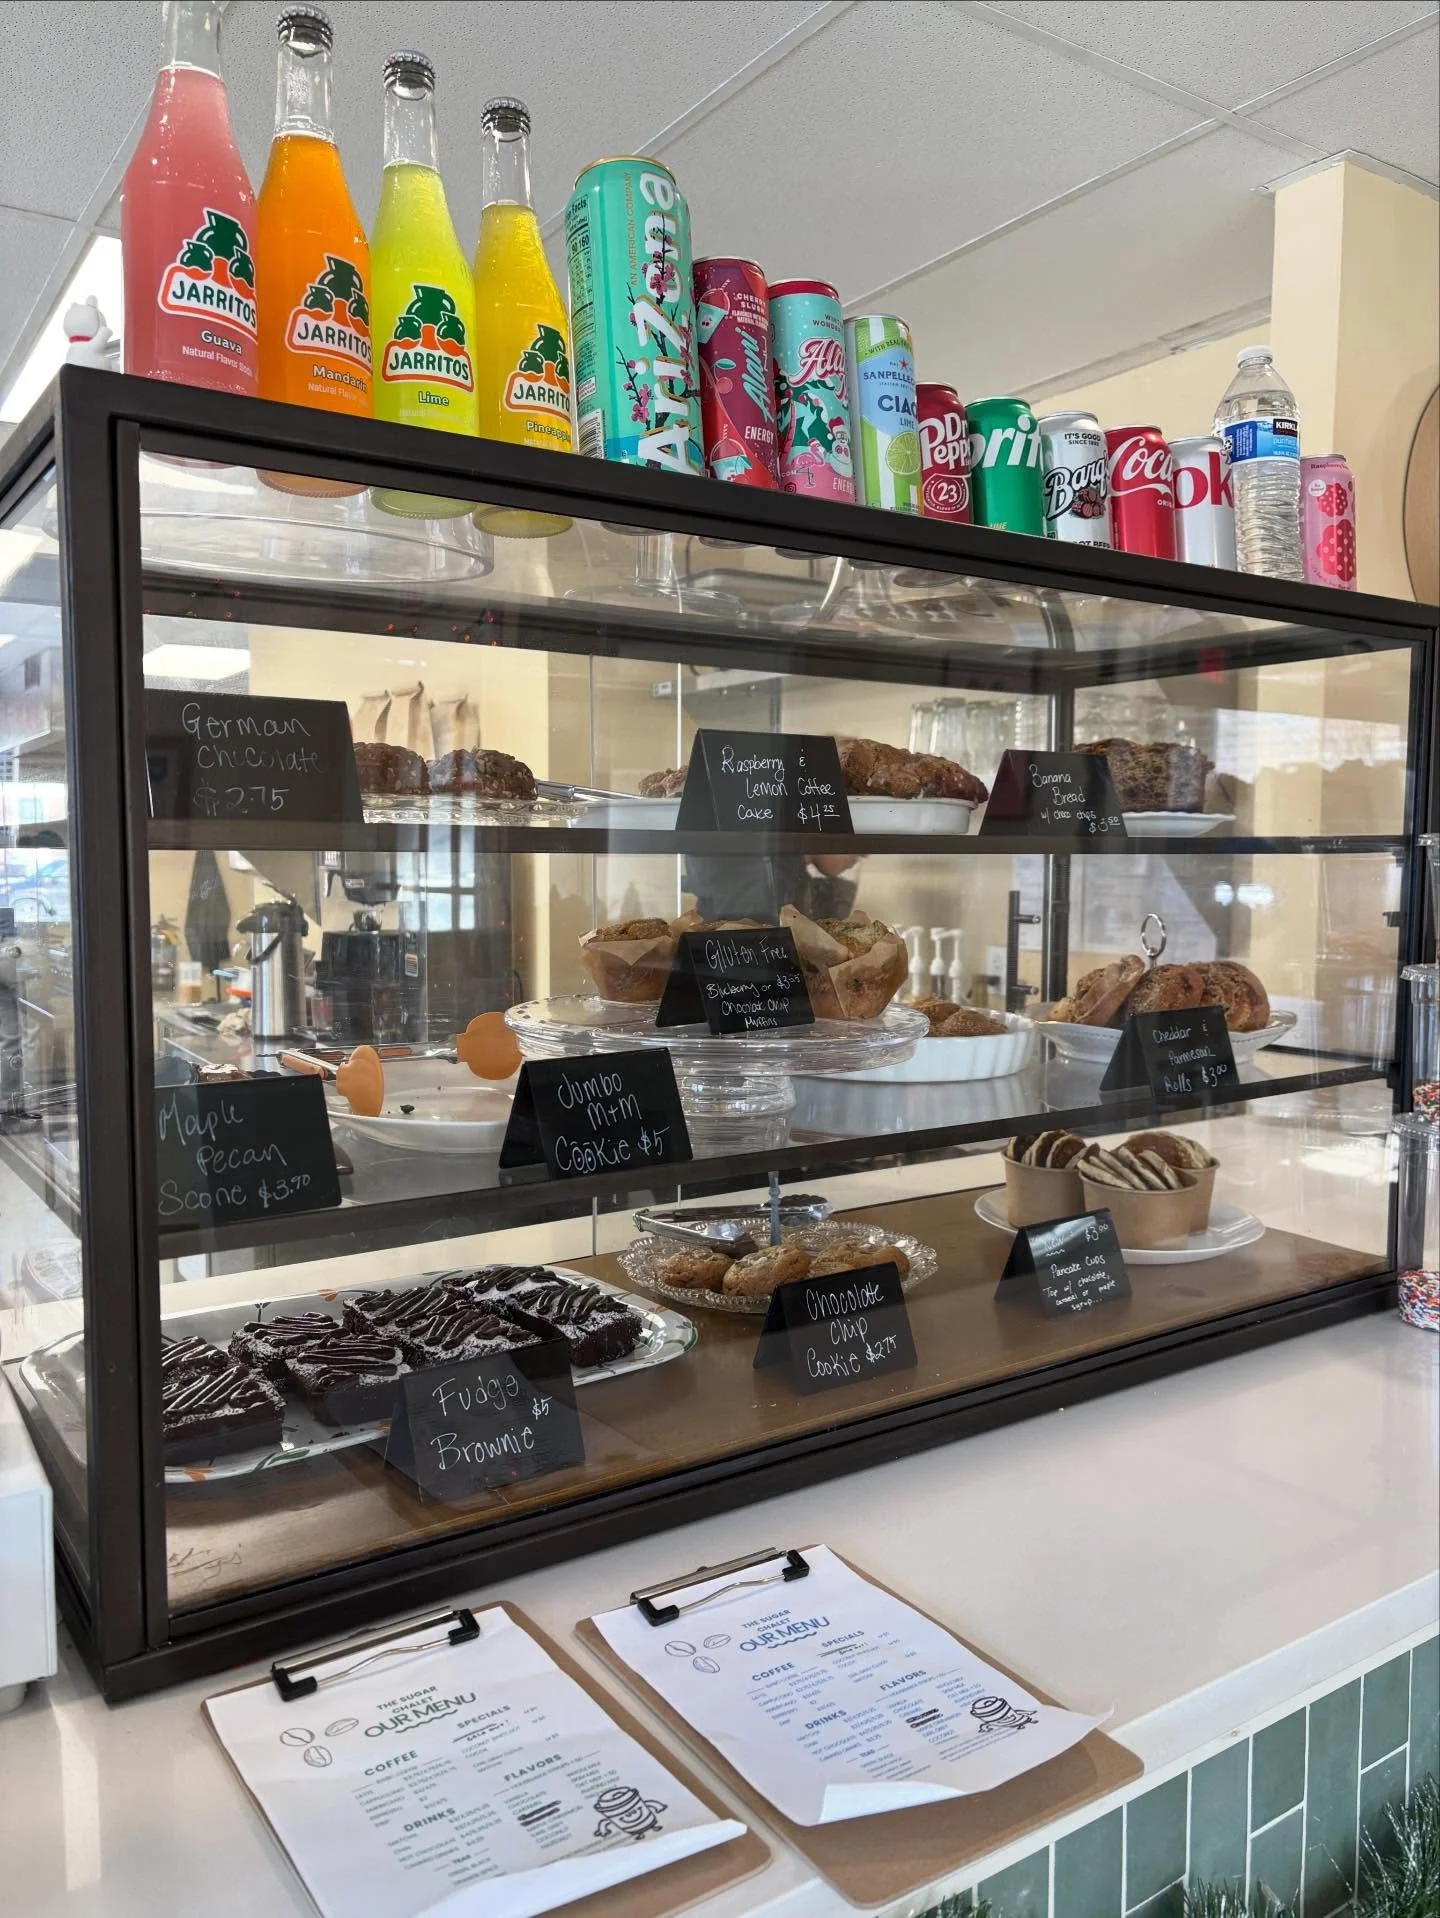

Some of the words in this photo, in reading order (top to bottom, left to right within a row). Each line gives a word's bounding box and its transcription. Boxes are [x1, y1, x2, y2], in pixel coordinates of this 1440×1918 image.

[172, 280, 257, 329] JARRITOS
[182, 346, 215, 360] Natural
[201, 330, 242, 355] Guava
[389, 352, 470, 382] JARRITOS
[308, 383, 337, 395] Natural
[418, 390, 449, 406] Lime
[744, 425, 774, 445] ENERGY
[943, 412, 969, 442] Dr
[937, 482, 959, 503] 23
[181, 702, 312, 740] German
[721, 744, 785, 783] Raspberry
[1028, 763, 1072, 788] Banana
[746, 778, 788, 799] Lemon
[797, 776, 836, 797] Coffee
[1052, 786, 1087, 806] Bread
[737, 804, 774, 821] Cake
[759, 935, 788, 964] Free
[761, 984, 772, 993] or
[1152, 1025, 1192, 1043] Cheddar
[1167, 1045, 1216, 1066] Parmesan
[557, 1072, 622, 1109] Jumbo
[158, 1091, 245, 1146] Maple
[586, 1093, 643, 1131] M+M
[196, 1143, 288, 1176] Pecan
[555, 1135, 631, 1174] Cookie
[637, 1126, 671, 1156] $5
[157, 1179, 247, 1216] Scone
[1050, 1263, 1082, 1279] Pancake
[1085, 1255, 1106, 1267] Cups
[806, 1282, 884, 1321] Chocolate
[1042, 1286, 1059, 1298] Top
[806, 1347, 861, 1378] Cookie
[431, 1374, 519, 1417] Fudge
[532, 1395, 553, 1420] $5
[430, 1426, 535, 1470] Brownie
[741, 1620, 759, 1630] THE
[760, 1609, 791, 1625] SUGAR
[756, 1617, 791, 1633] CHALET
[739, 1631, 778, 1652] OUR
[779, 1616, 830, 1639] MENU
[821, 1629, 865, 1648] SPECIALS
[751, 1661, 796, 1682] COFFEE
[879, 1669, 927, 1691] FLAVORS
[375, 1699, 398, 1711] THE
[399, 1685, 438, 1703] SUGAR
[391, 1695, 434, 1714] CHALET
[363, 1713, 410, 1738] OUR
[411, 1691, 477, 1721] MENU
[456, 1704, 512, 1729] SPECIALS
[804, 1709, 847, 1730] DRINKS
[364, 1749, 418, 1776] COFFEE
[503, 1753, 563, 1782] FLAVORS
[403, 1807, 456, 1832] DRINKS
